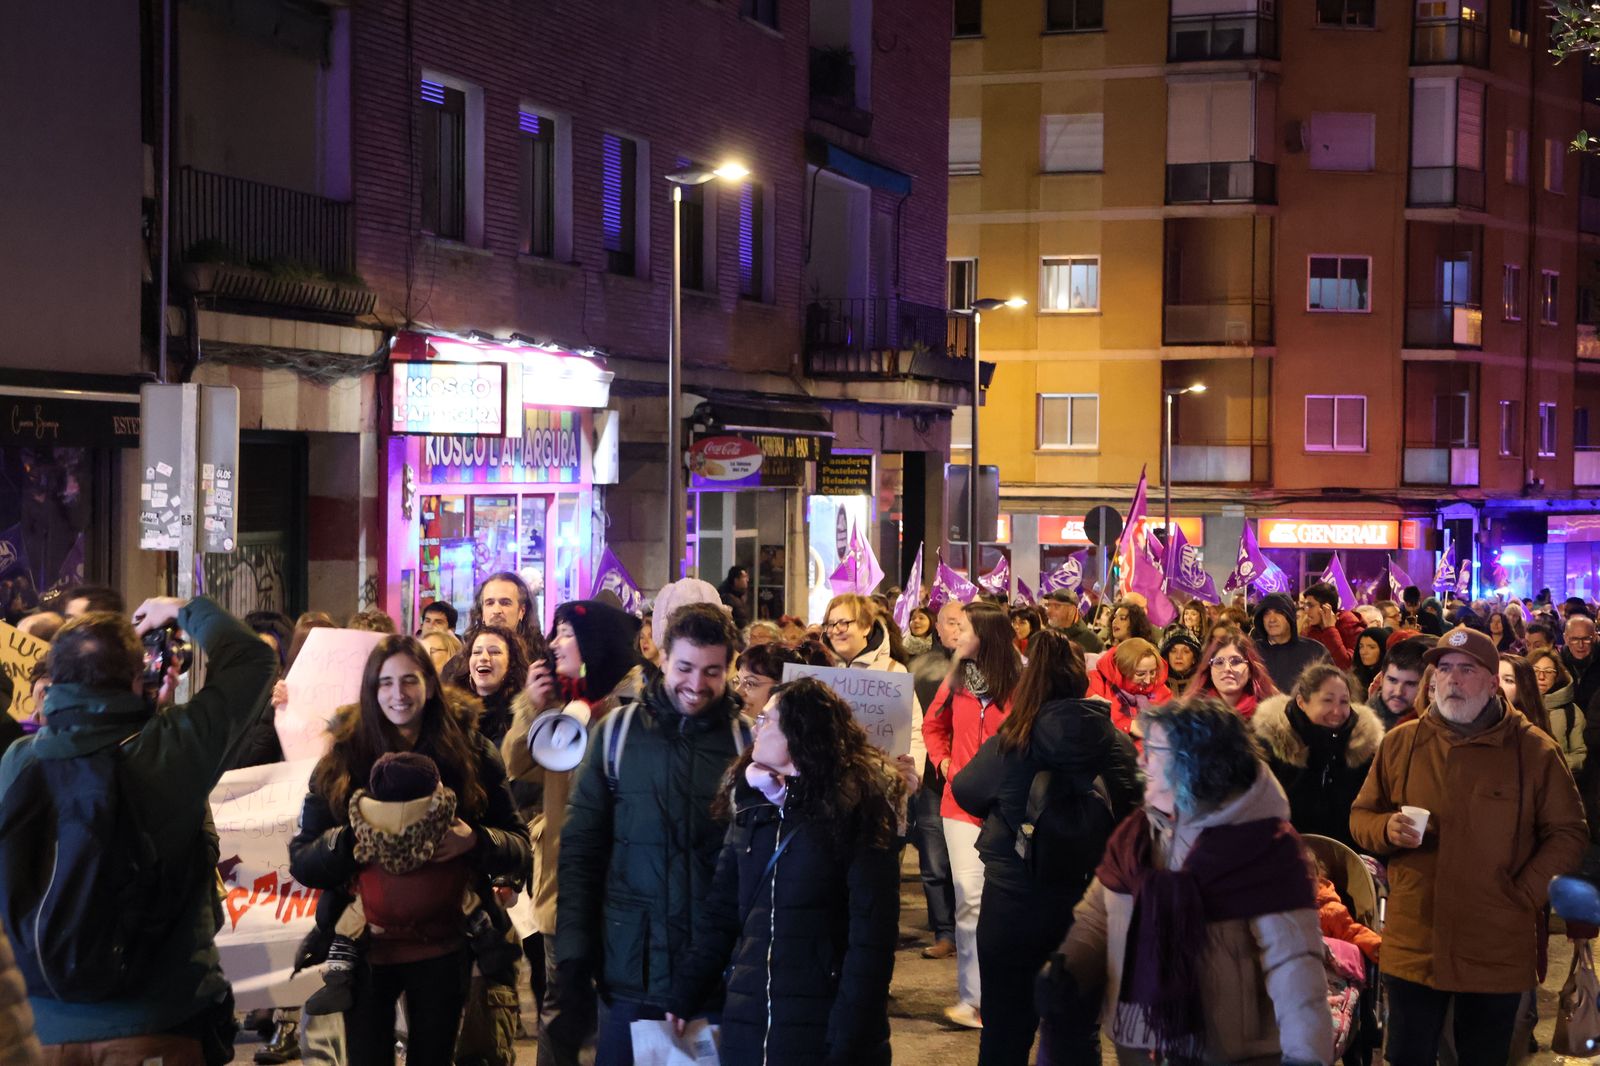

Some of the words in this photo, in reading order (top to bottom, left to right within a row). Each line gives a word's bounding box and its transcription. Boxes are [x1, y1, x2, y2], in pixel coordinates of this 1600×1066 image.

[407, 377, 492, 399] KIOSCO
[426, 436, 486, 467] KIOSCO
[1297, 524, 1389, 545] GENERALI
[831, 676, 903, 699] MUJERES
[851, 701, 885, 715] OMOS
